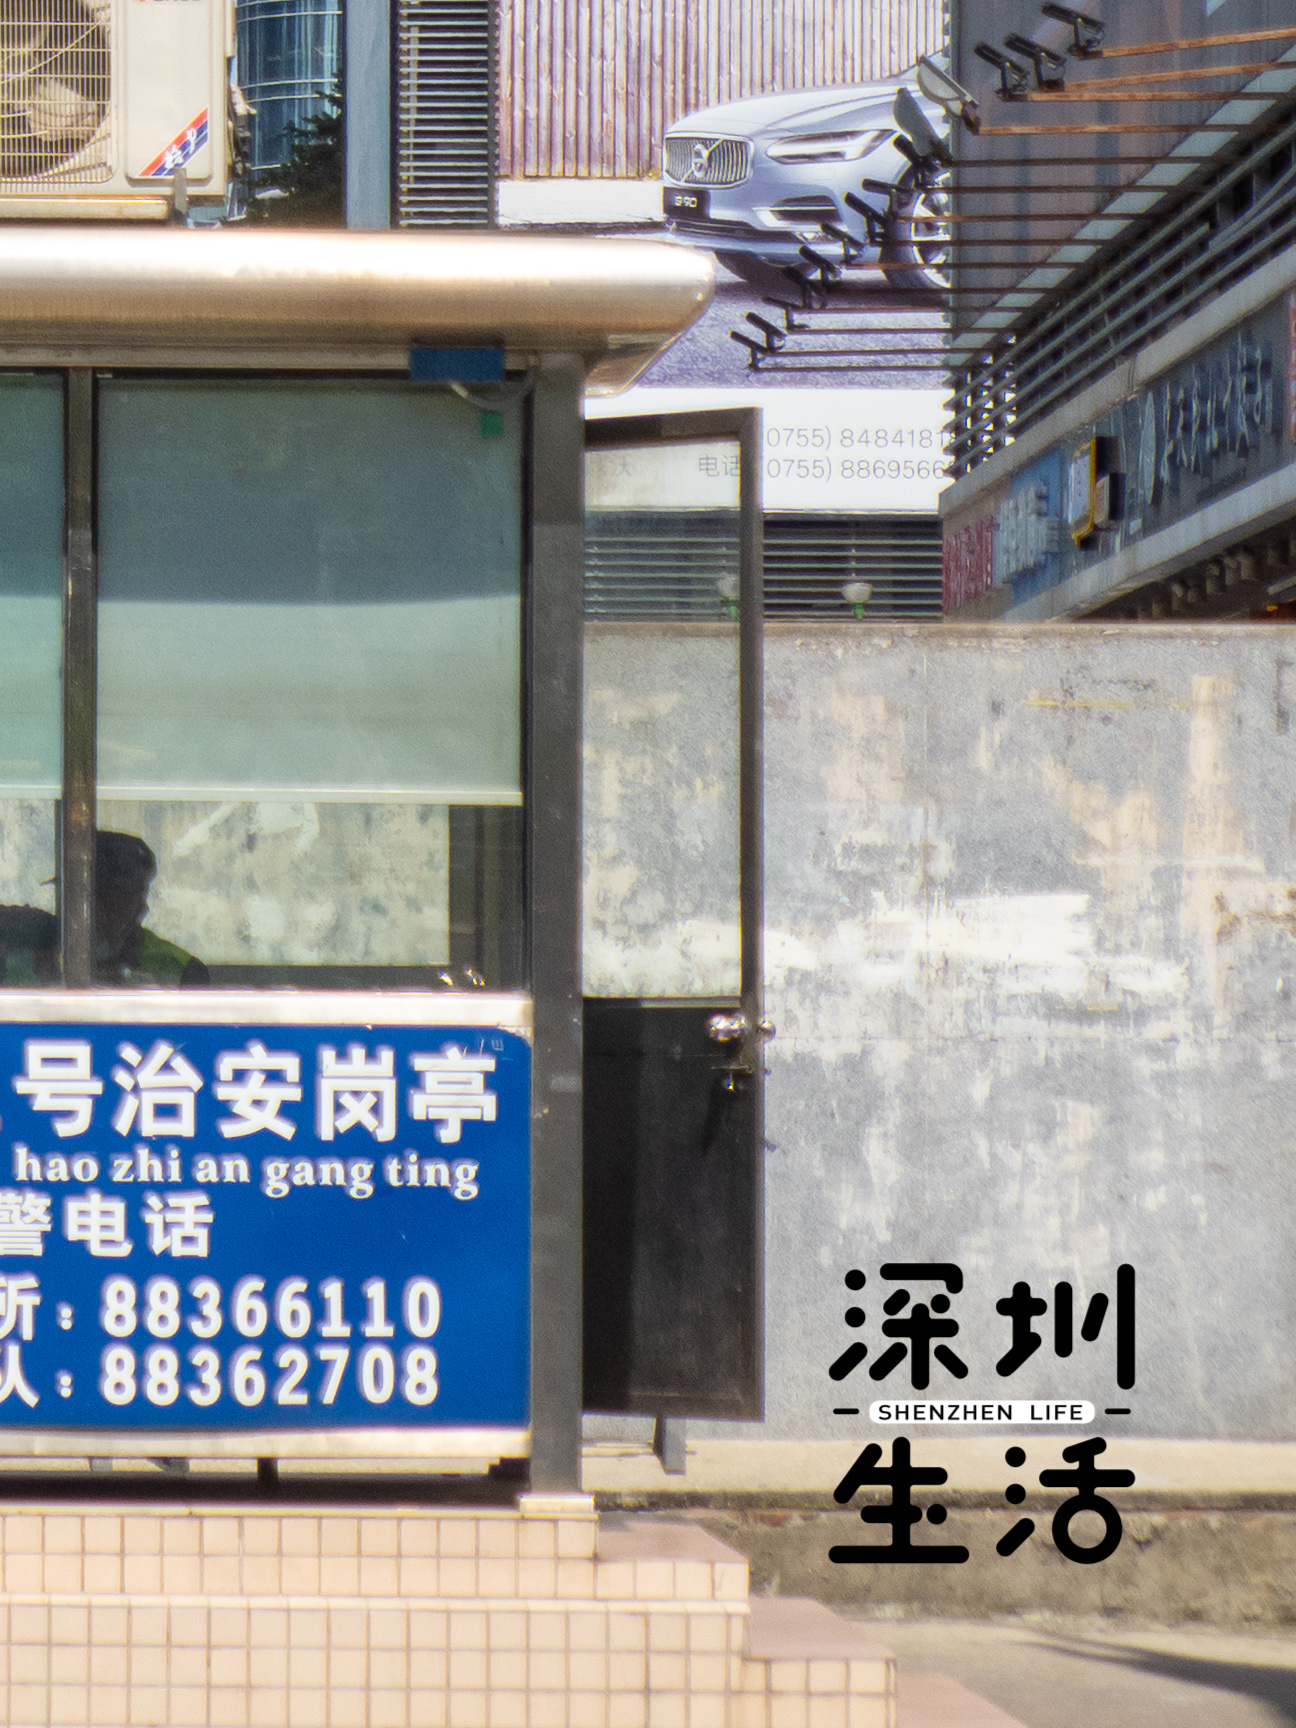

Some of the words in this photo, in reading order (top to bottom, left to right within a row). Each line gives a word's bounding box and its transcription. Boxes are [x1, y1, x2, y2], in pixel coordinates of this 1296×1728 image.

[766, 426, 832, 451] 0755)
[839, 428, 956, 448] 8484181
[766, 457, 833, 482] 0755)
[840, 458, 956, 479] 8869566
[14, 1146, 99, 1183] hao
[110, 1145, 184, 1184] zhi
[195, 1155, 252, 1184] an
[263, 1156, 375, 1199] gang
[383, 1149, 480, 1201] ting
